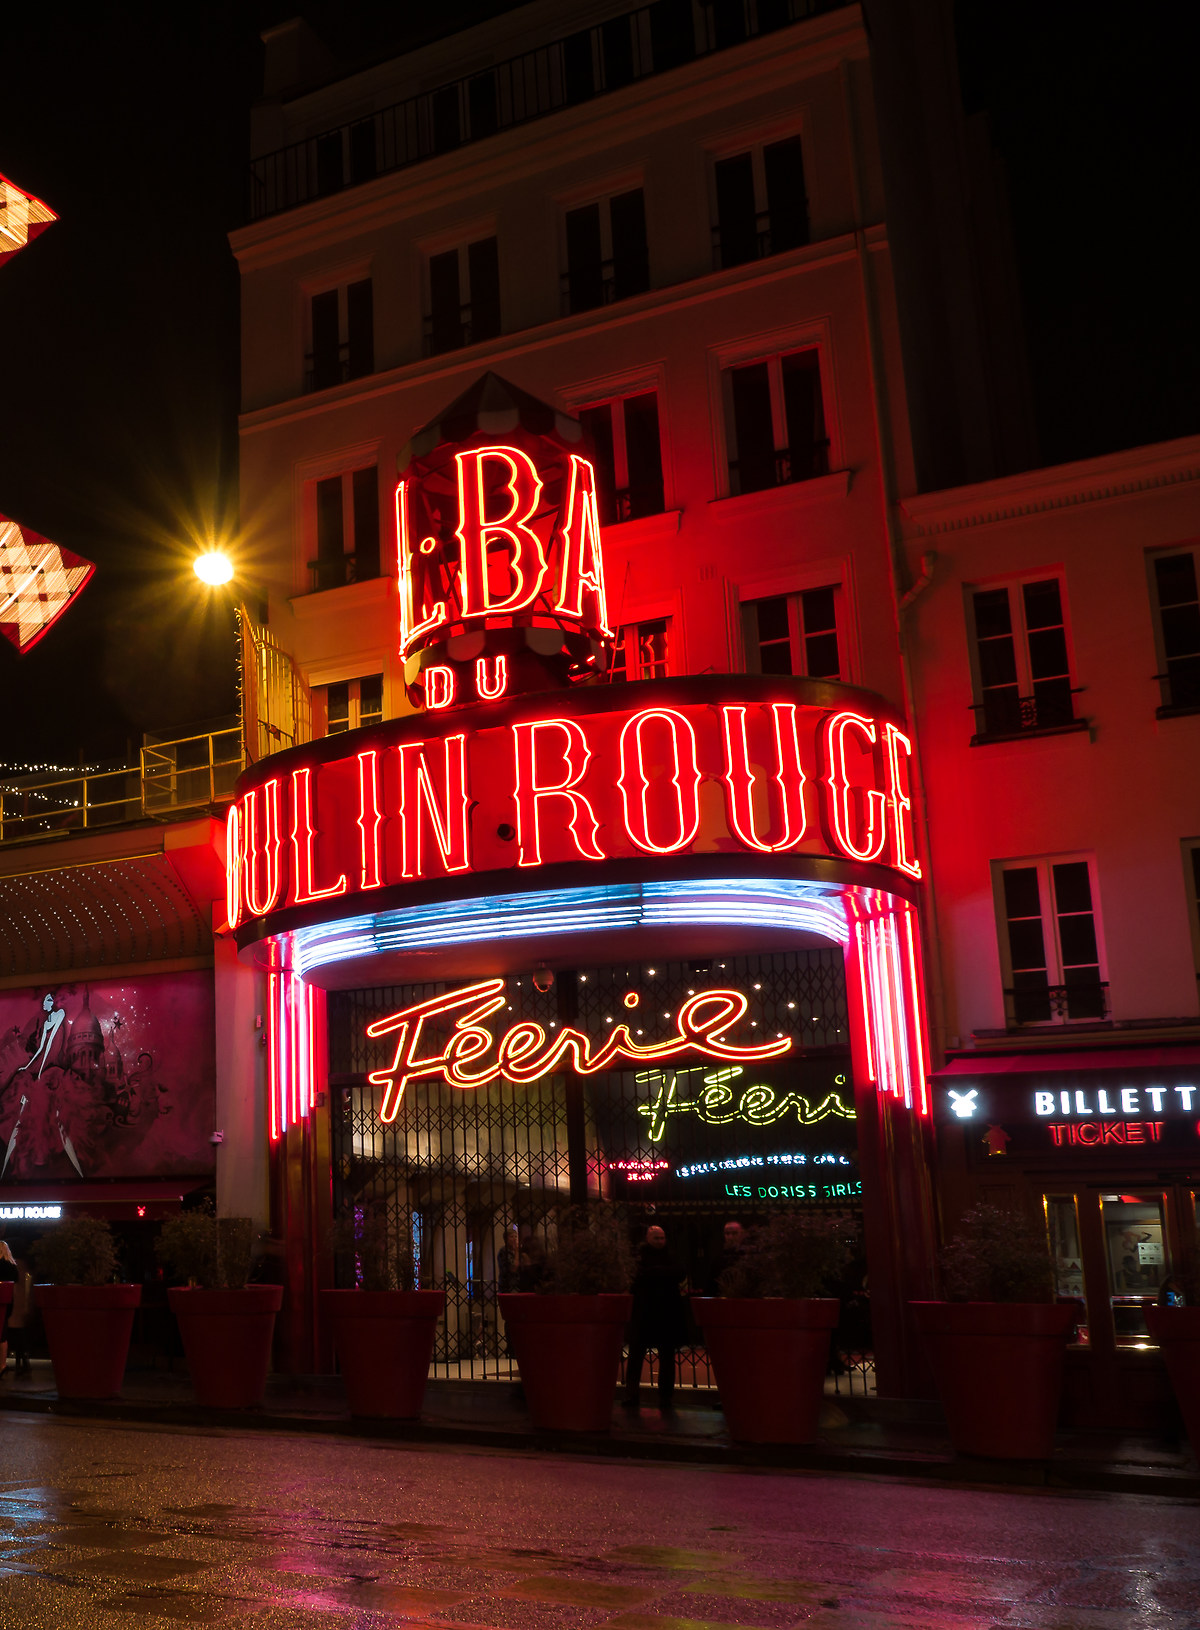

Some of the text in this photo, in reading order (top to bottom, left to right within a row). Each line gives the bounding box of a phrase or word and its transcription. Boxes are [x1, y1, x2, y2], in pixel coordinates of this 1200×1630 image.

[425, 655, 507, 709] DU
[513, 703, 922, 880] ROUGE
[367, 978, 793, 1123] Féerie
[1034, 1086, 1197, 1116] BILLETT
[1048, 1122, 1164, 1145] TICKET
[725, 1184, 752, 1198] LES
[24, 1206, 61, 1219] ROUGE
